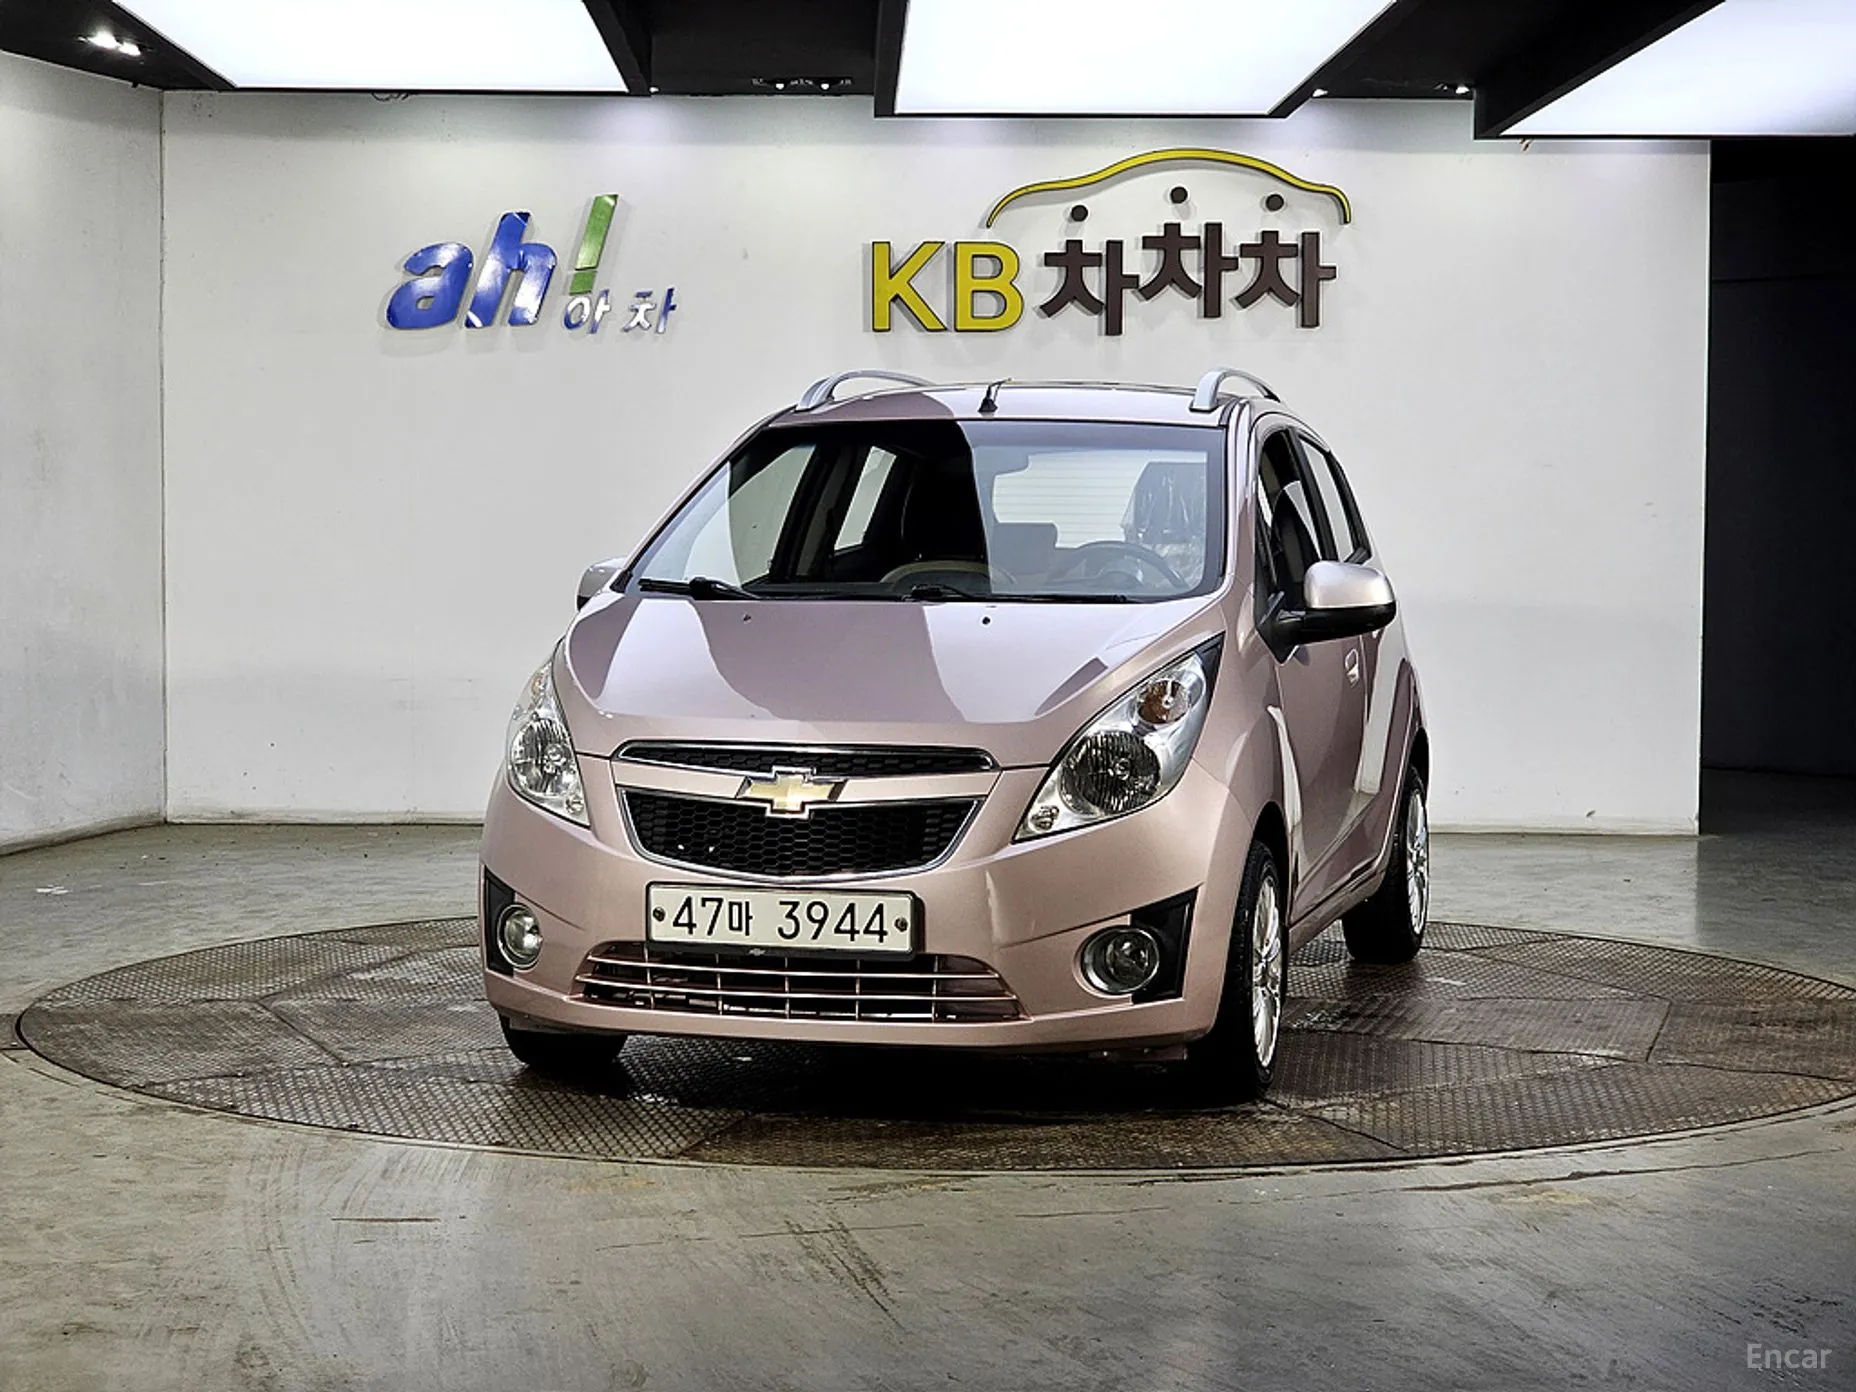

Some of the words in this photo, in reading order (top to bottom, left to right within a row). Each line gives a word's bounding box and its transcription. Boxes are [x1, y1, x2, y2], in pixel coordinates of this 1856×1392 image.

[386, 193, 619, 330] ah!
[671, 896, 754, 937] 47마
[776, 899, 889, 943] 3944
